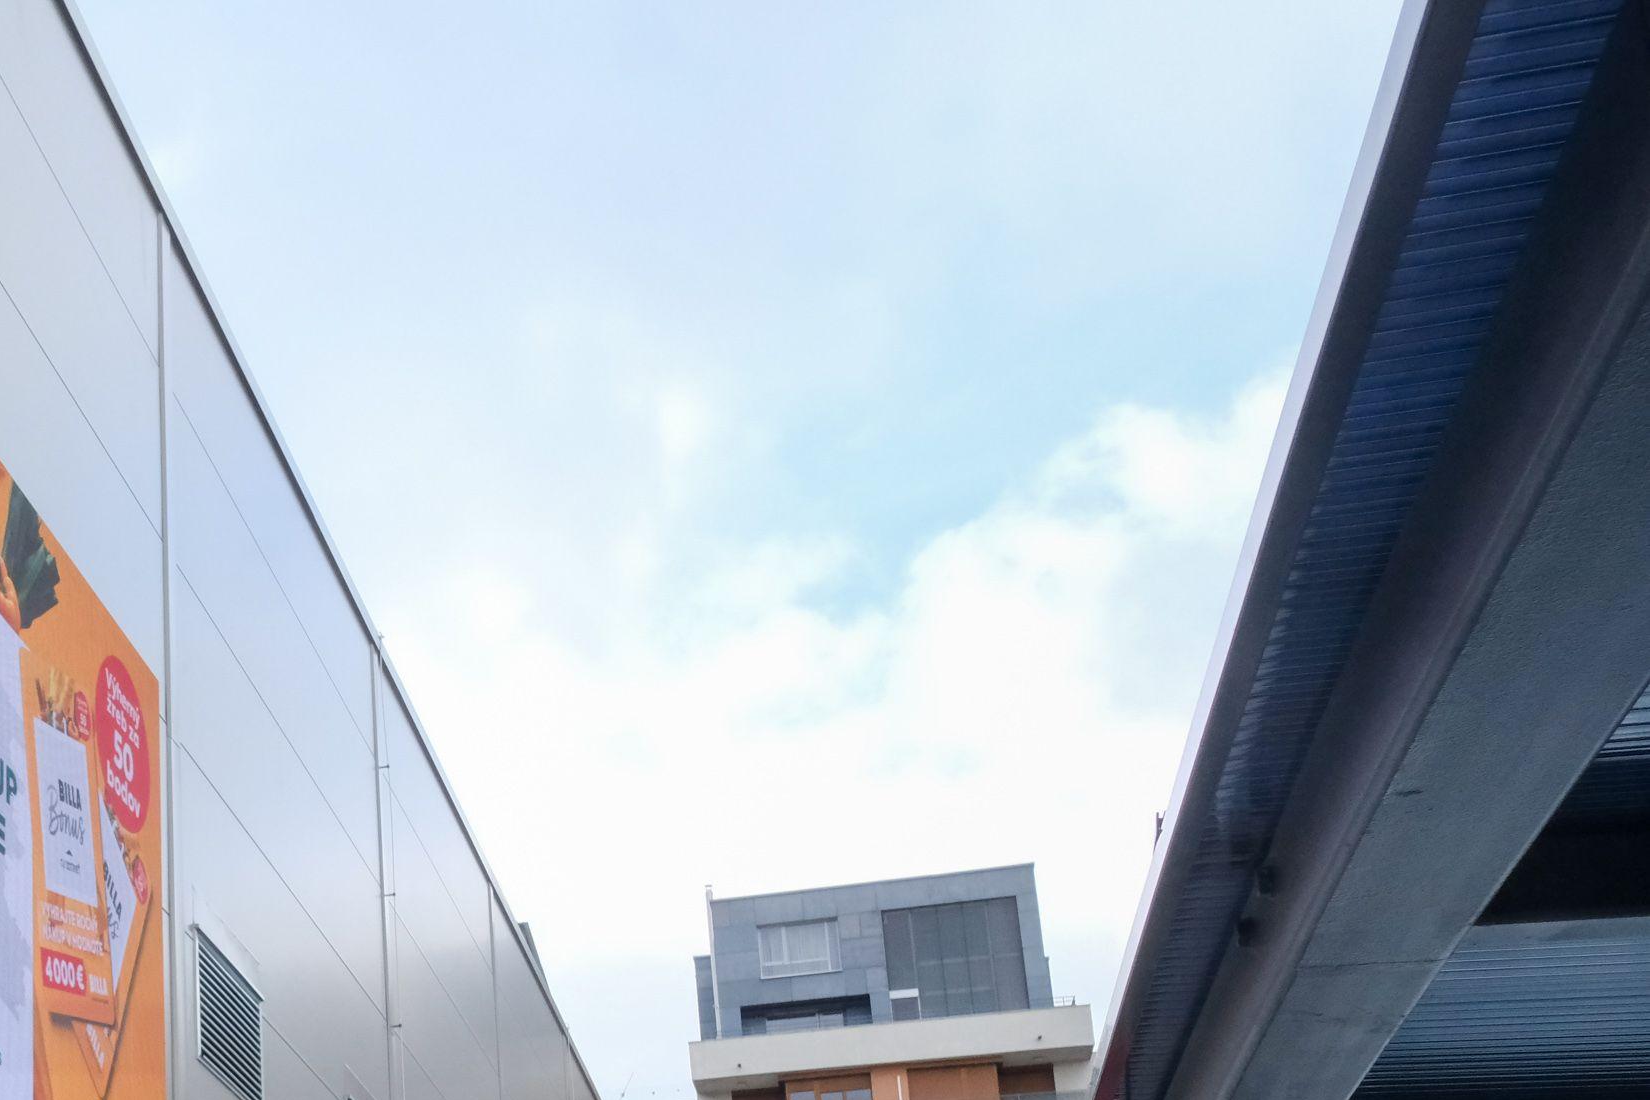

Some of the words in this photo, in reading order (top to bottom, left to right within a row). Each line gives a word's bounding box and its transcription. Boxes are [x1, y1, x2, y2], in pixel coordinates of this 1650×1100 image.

[104, 667, 141, 731] Výherný
[107, 693, 128, 733] žreb
[128, 726, 140, 749] za
[113, 730, 134, 782] 50
[58, 778, 82, 810] BILLA
[106, 760, 141, 818] bodov
